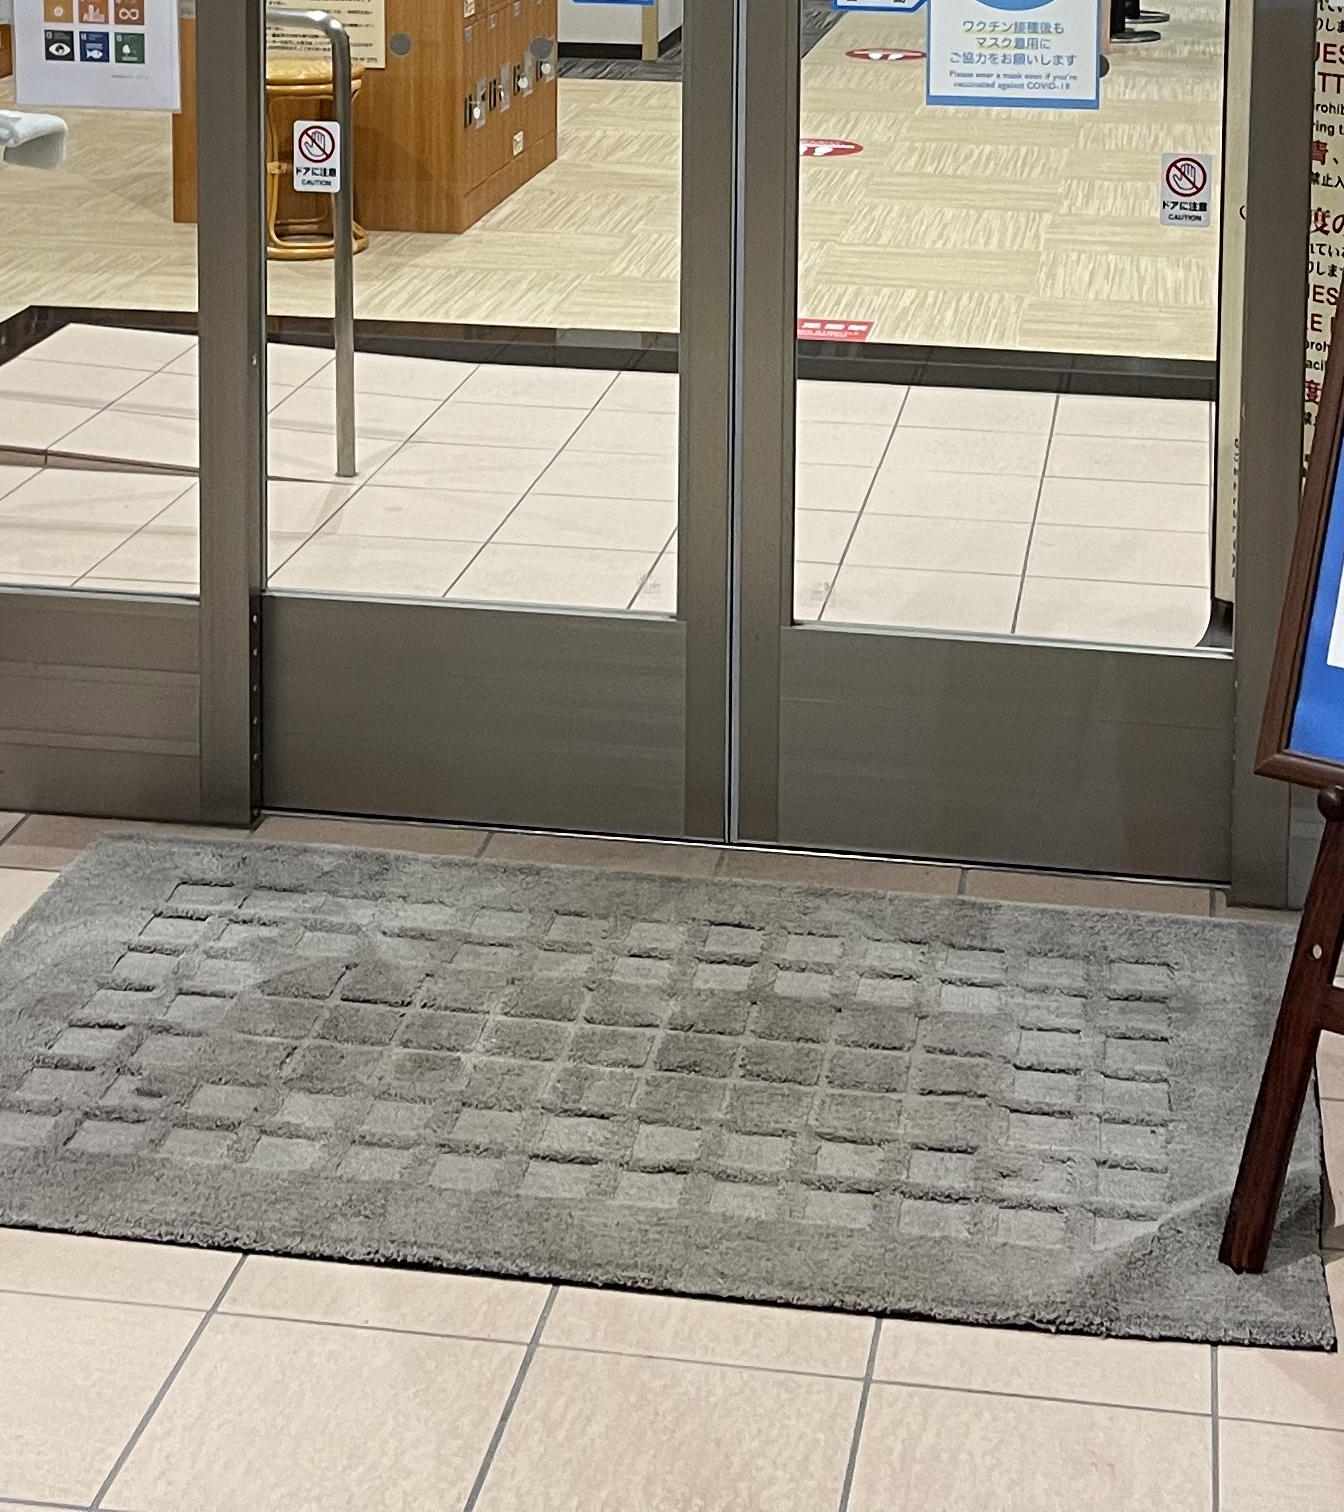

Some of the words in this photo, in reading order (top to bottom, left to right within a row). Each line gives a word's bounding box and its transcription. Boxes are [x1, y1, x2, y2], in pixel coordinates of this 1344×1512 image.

[962, 20, 1065, 35] ワクチン接種後も
[975, 36, 1051, 50] マスク着用に
[949, 52, 1077, 67] ご協力をお願いします
[296, 166, 337, 178] ドアに注意
[301, 178, 332, 186] CAUTION
[1162, 200, 1208, 212] ドアに注意
[1167, 213, 1202, 221] CAUTION
